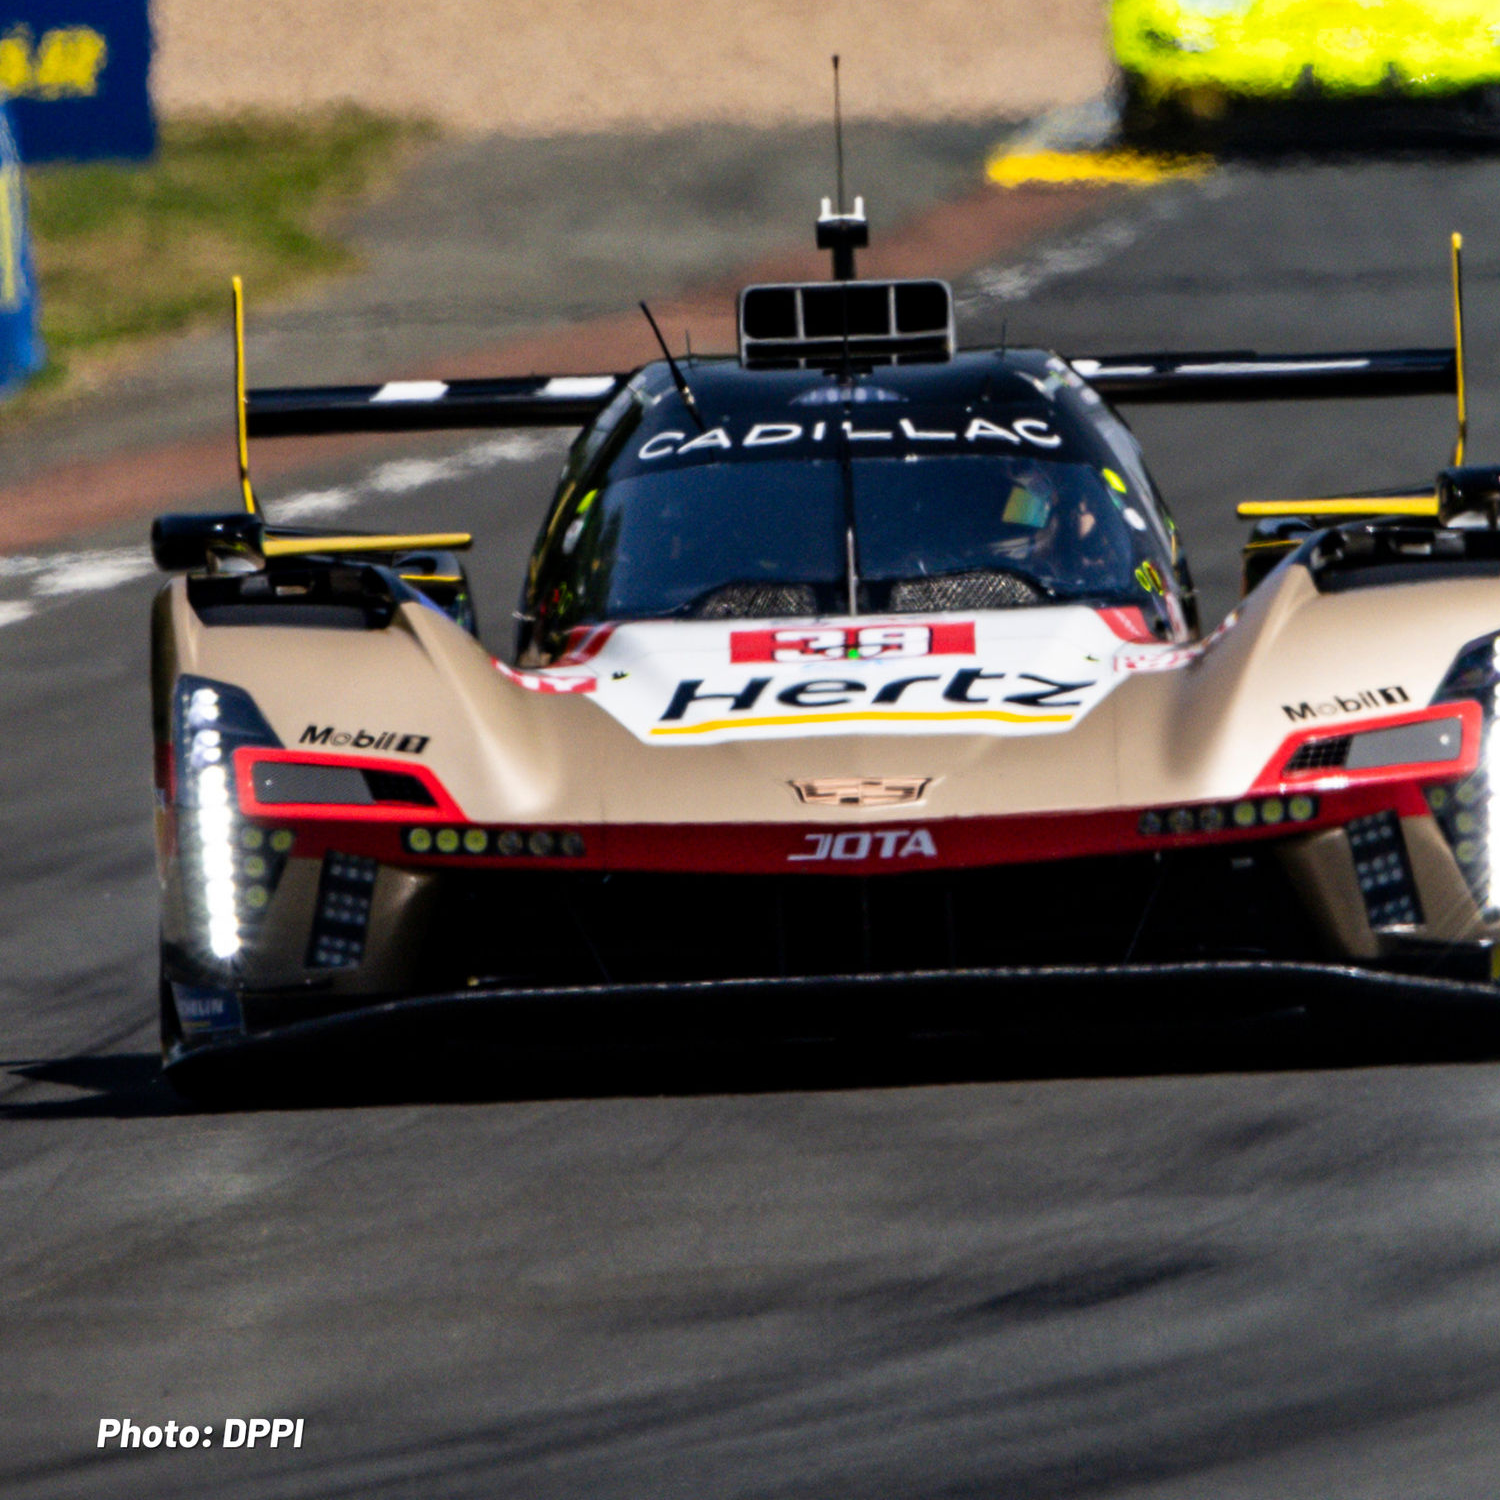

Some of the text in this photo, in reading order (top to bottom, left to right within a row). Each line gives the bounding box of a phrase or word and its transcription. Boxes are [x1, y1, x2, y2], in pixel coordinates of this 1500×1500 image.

[637, 417, 1063, 461] CADILLAC
[660, 668, 1098, 722] Hertz
[1280, 689, 1380, 723] Mobil
[298, 724, 396, 752] Mobil
[786, 829, 937, 862] JOTA
